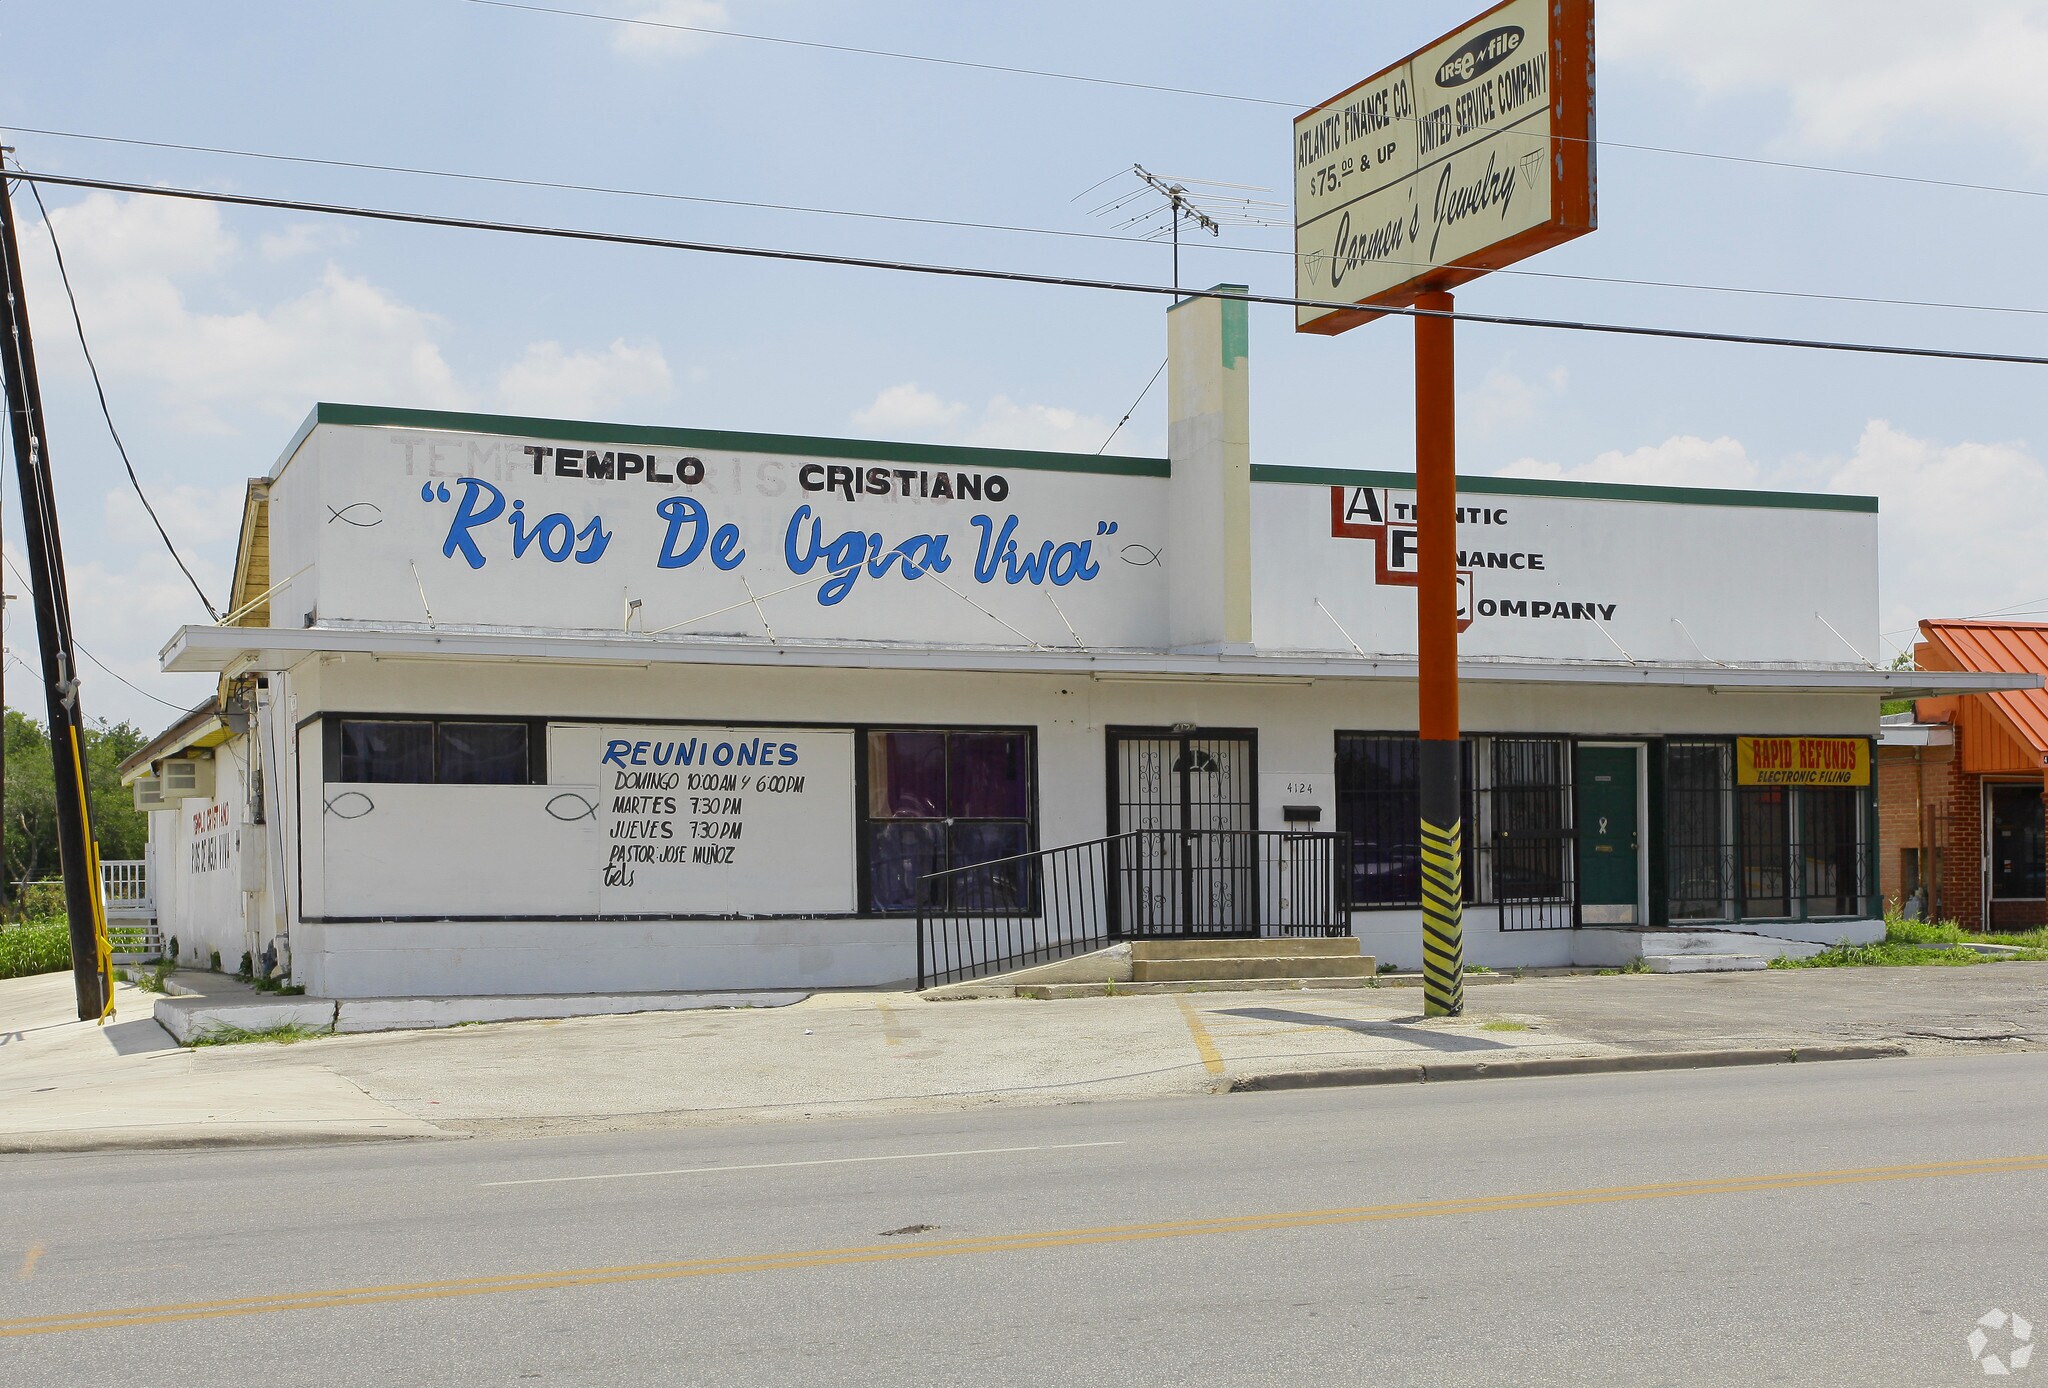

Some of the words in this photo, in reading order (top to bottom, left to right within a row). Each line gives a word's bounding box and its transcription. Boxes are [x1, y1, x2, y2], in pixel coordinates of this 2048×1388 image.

[1419, 103, 1451, 156] UNITED
[1456, 80, 1496, 138] SERVICE
[1498, 51, 1547, 116] COMPANY
[1298, 113, 1341, 170] ATLANTIC
[1344, 88, 1390, 145] FINANCE
[1393, 79, 1412, 121] CO.
[1360, 154, 1371, 172] &
[1377, 142, 1397, 164] UP
[1331, 186, 1420, 288] Carmen's
[1429, 150, 1517, 263] Jewelry
[524, 445, 705, 485] TEMPLO
[799, 463, 1009, 502] CRISTIANO
[656, 496, 746, 571] De
[602, 738, 799, 769] REUNIONES
[1752, 739, 1793, 769] RAPID
[1799, 739, 1857, 770] REFUNDS
[614, 771, 680, 791] DOMINGO
[1287, 782, 1313, 794] 4124
[1757, 771, 1817, 783] ELECTRONIC
[1818, 771, 1852, 783] FILING
[612, 796, 677, 815] MARTES
[609, 820, 674, 839] JUEVES
[659, 845, 687, 864] JOSE
[692, 843, 736, 864] MUÑOZ
[602, 862, 636, 888] tels
